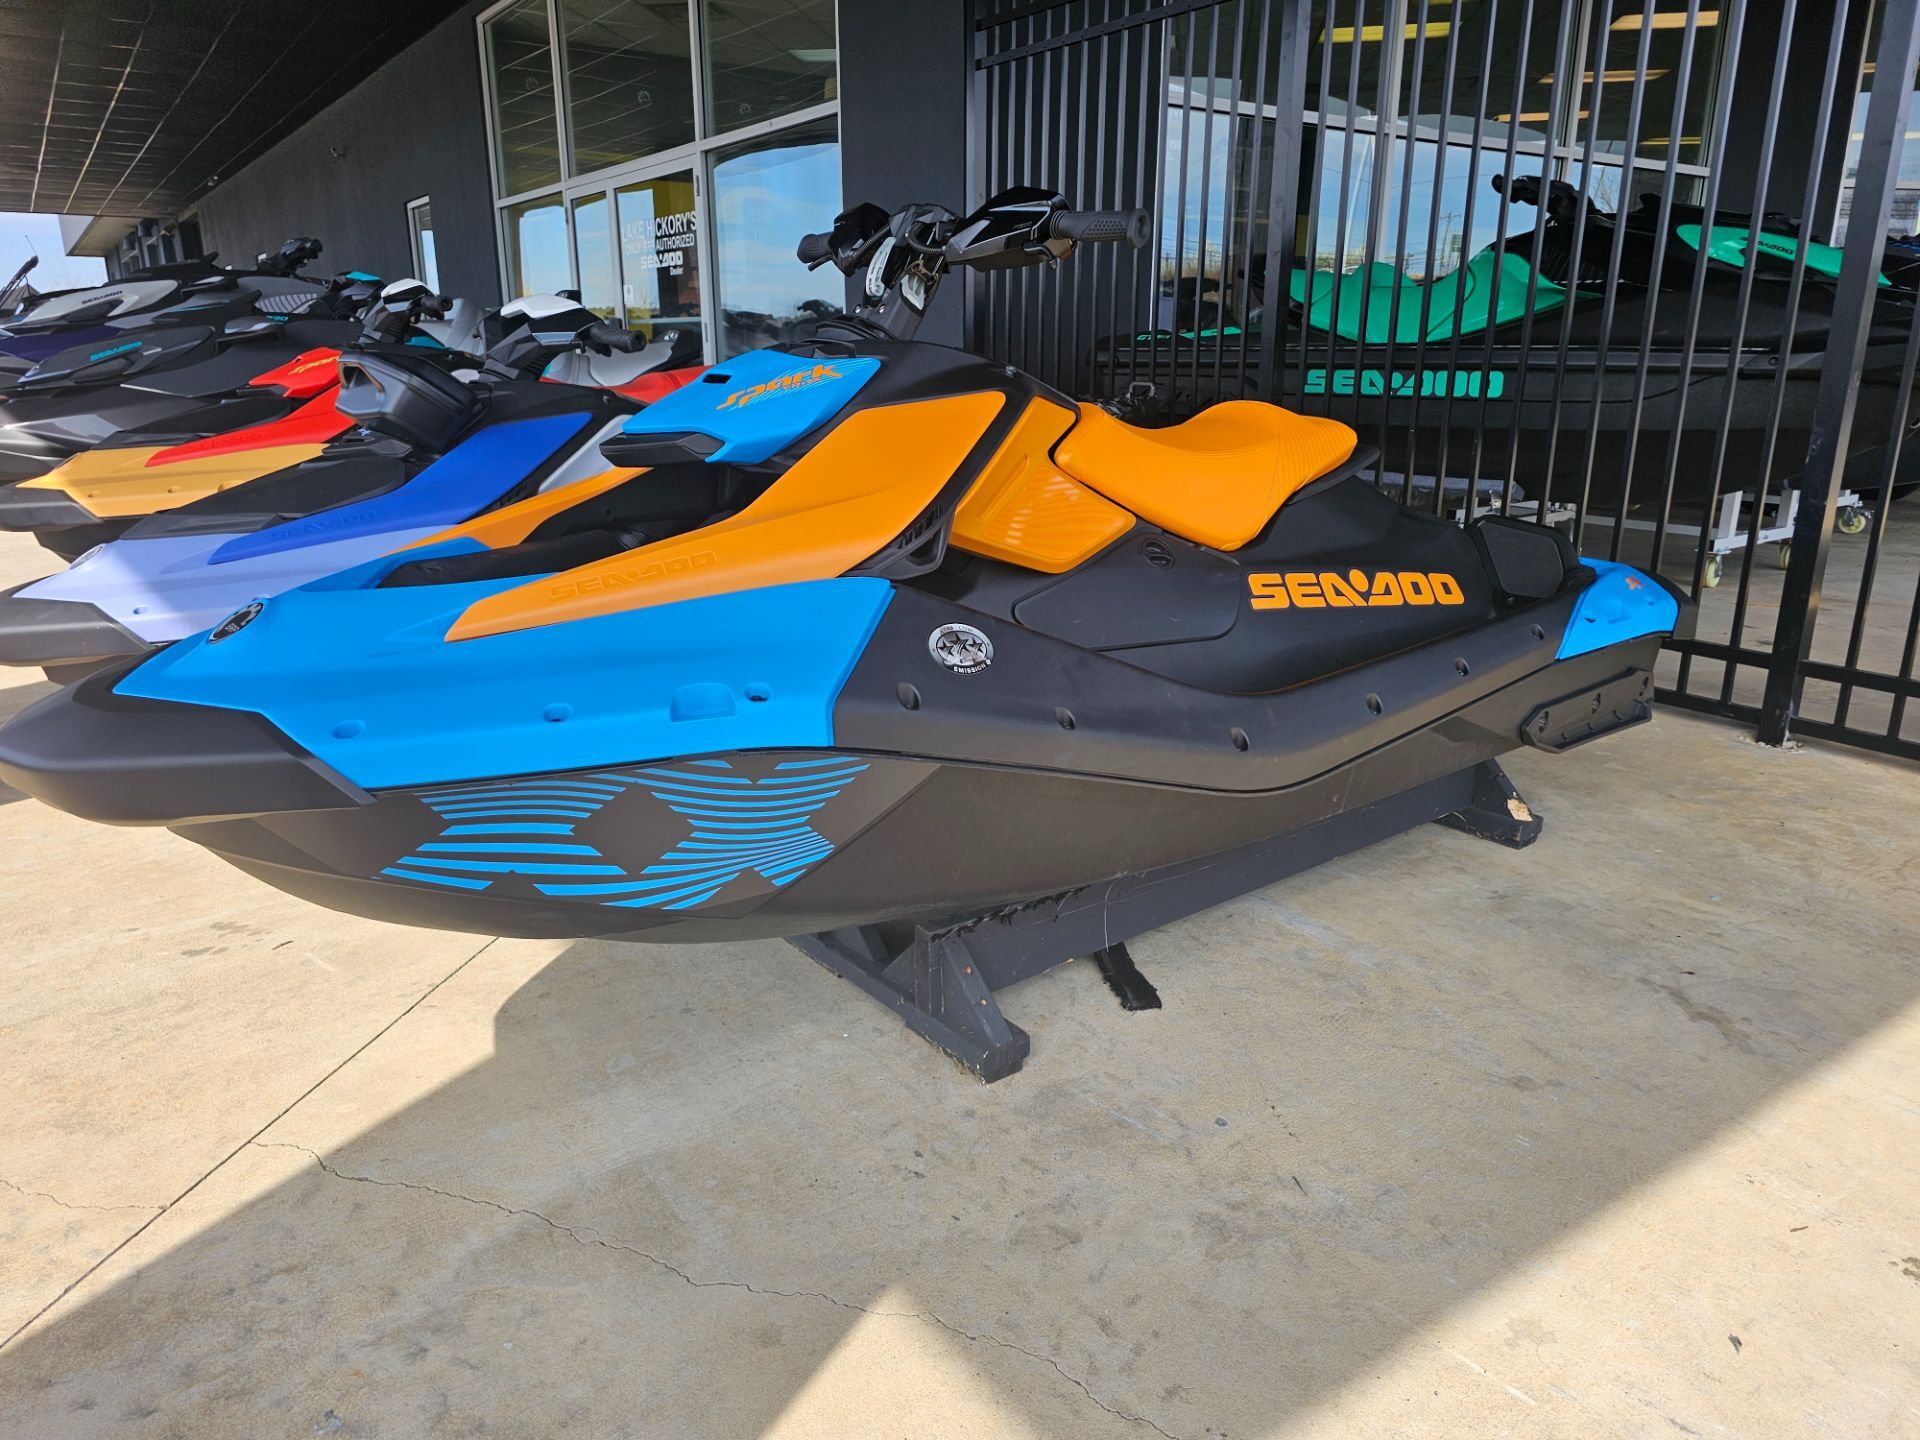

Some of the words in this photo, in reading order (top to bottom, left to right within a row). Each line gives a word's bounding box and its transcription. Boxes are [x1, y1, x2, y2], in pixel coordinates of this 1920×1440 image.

[621, 221, 645, 243] LAKE
[646, 210, 697, 237] HICKORY'S
[656, 233, 695, 251] AUTHORIZED
[669, 267, 684, 276] Dealer
